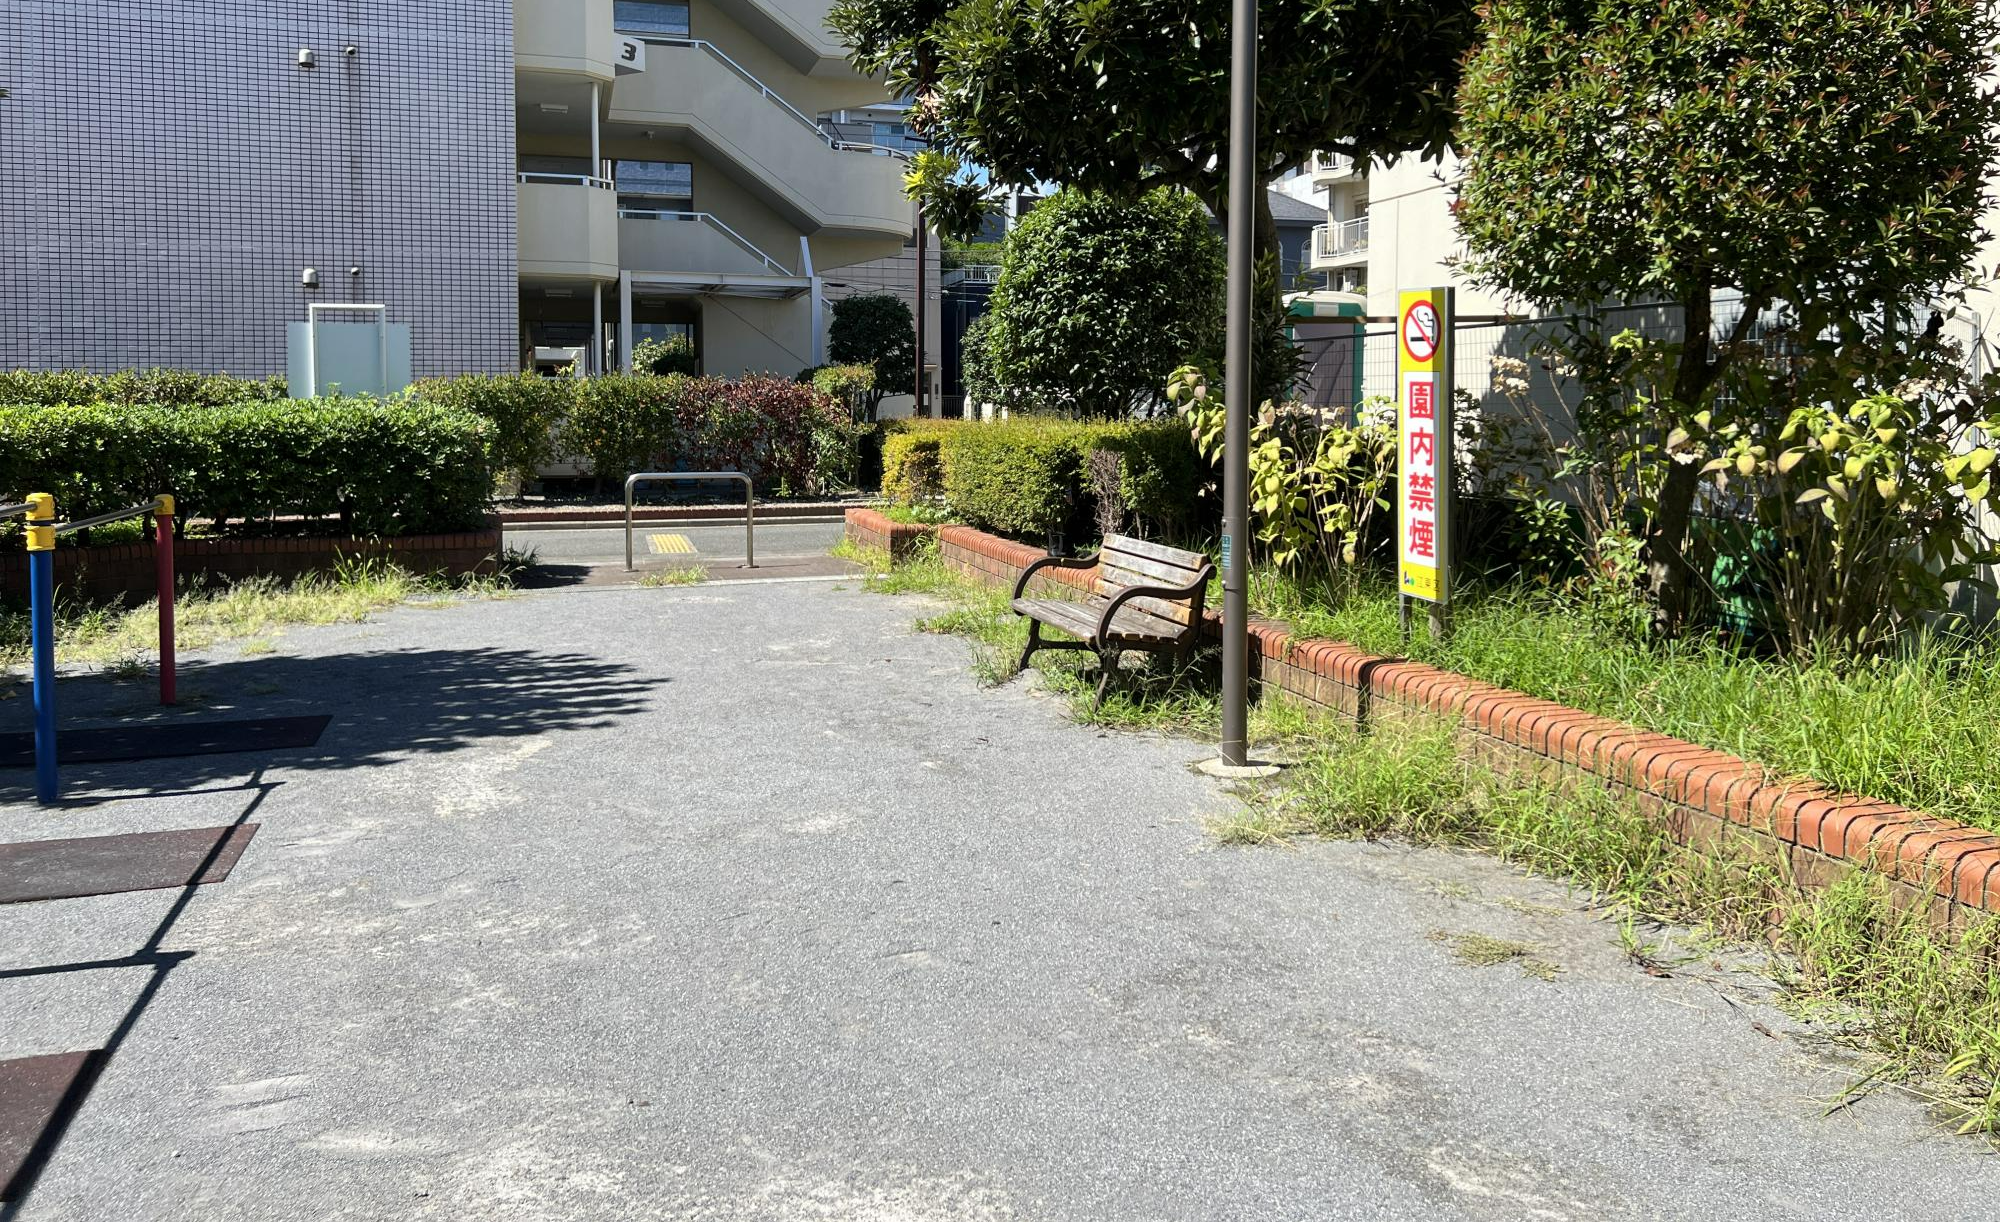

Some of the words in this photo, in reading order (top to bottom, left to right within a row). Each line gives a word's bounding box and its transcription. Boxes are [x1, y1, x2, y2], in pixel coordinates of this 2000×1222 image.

[621, 42, 637, 61] 3
[1409, 381, 1434, 557] 園内禁煙
